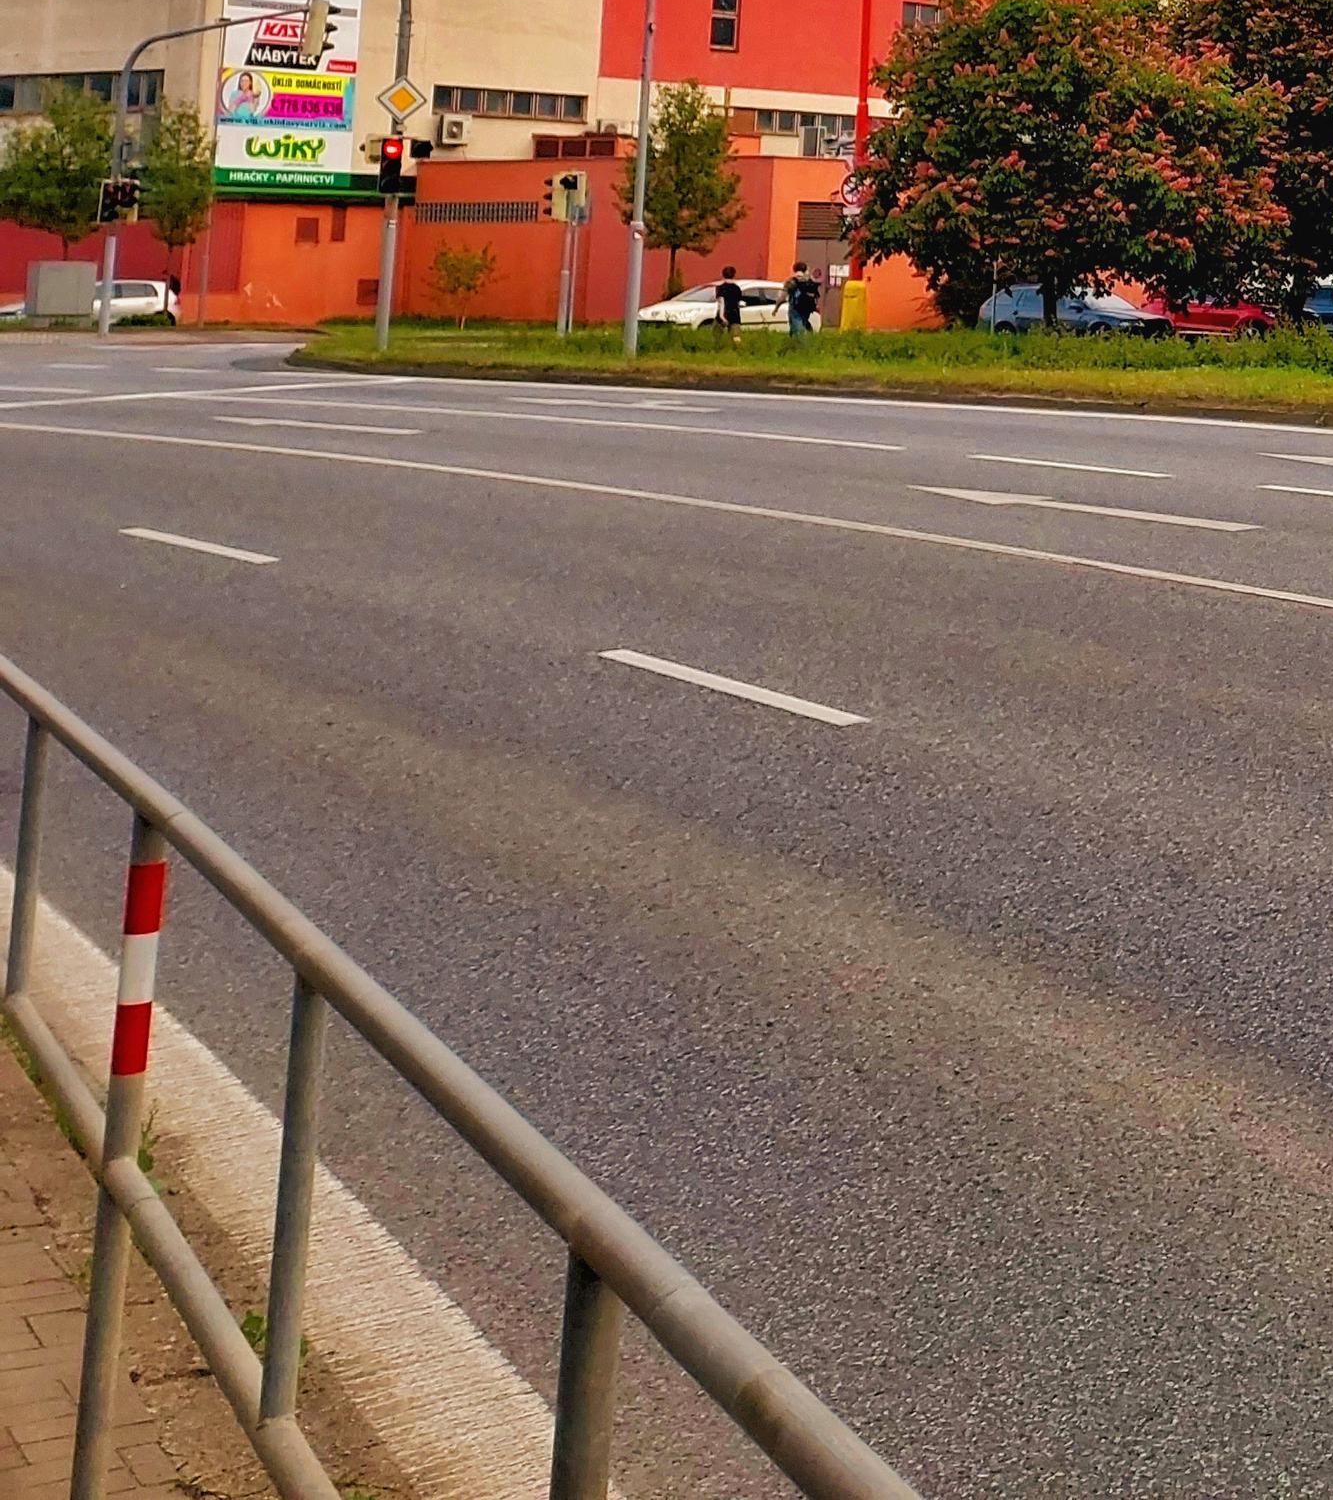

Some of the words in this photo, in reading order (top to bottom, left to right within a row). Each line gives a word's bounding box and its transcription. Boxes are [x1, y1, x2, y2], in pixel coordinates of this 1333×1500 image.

[262, 22, 302, 38] KAS
[251, 45, 317, 66] NÁBYTEK
[229, 170, 269, 182] HRAČKY
[276, 172, 335, 185] PAPÍRNICTVÍ
